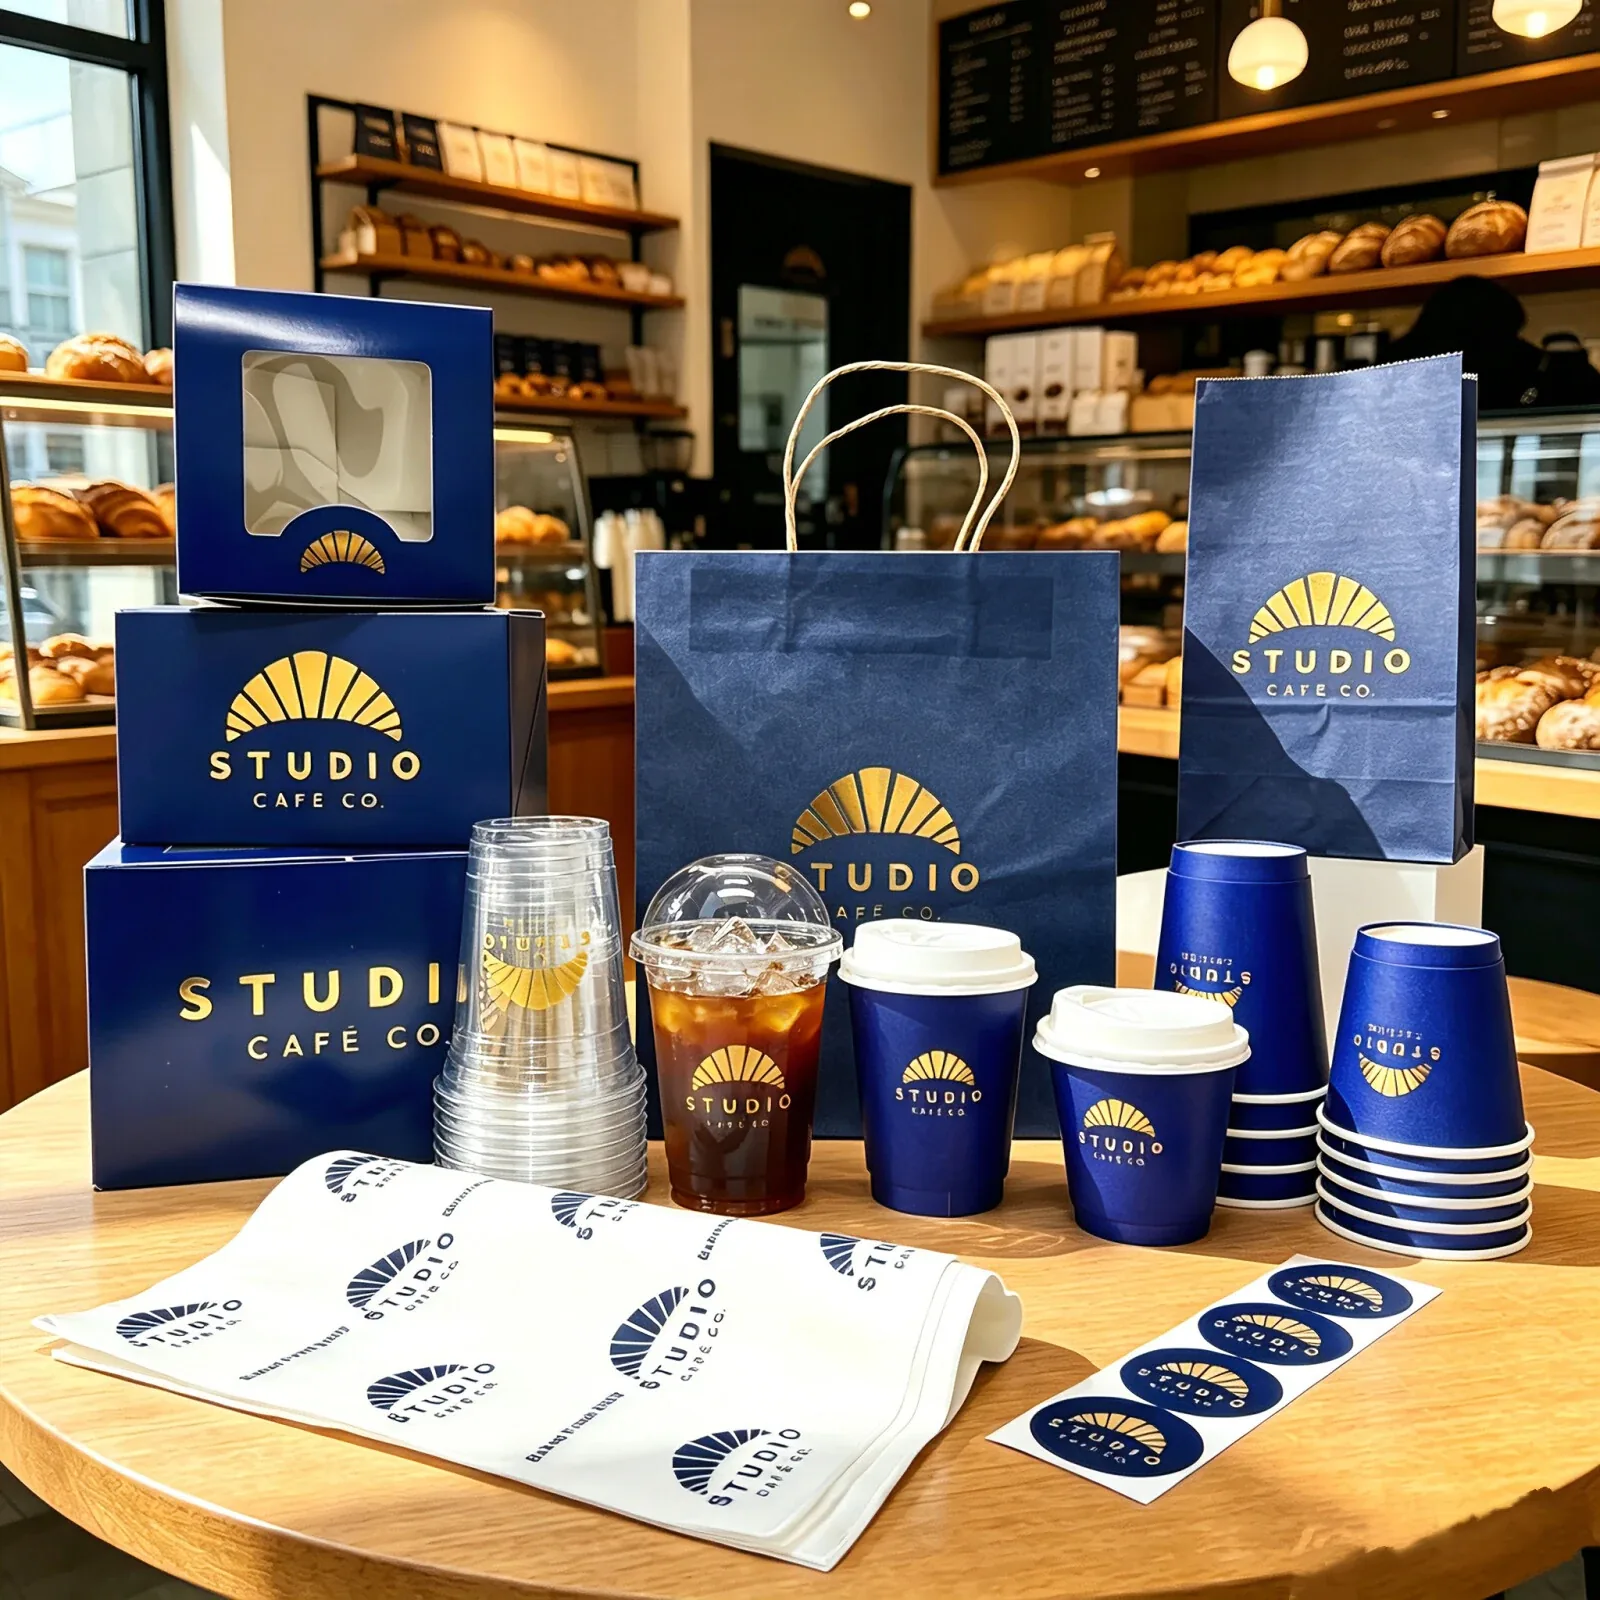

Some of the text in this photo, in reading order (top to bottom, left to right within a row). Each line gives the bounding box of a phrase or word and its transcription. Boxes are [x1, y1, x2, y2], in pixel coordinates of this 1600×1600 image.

[1231, 648, 1411, 674] STUDIO
[1340, 683, 1376, 698] CO.
[209, 750, 421, 781] STUDIO
[252, 792, 385, 809] CAFE CO.
[811, 862, 980, 892] TUDIO
[835, 904, 941, 920] AFE CO.
[179, 962, 467, 1021] STUDI
[247, 1025, 360, 1060] CAFÉ
[686, 1094, 791, 1115] STUDIO
[895, 1087, 982, 1104] STUDIO
[708, 1428, 801, 1507] STUDIO
